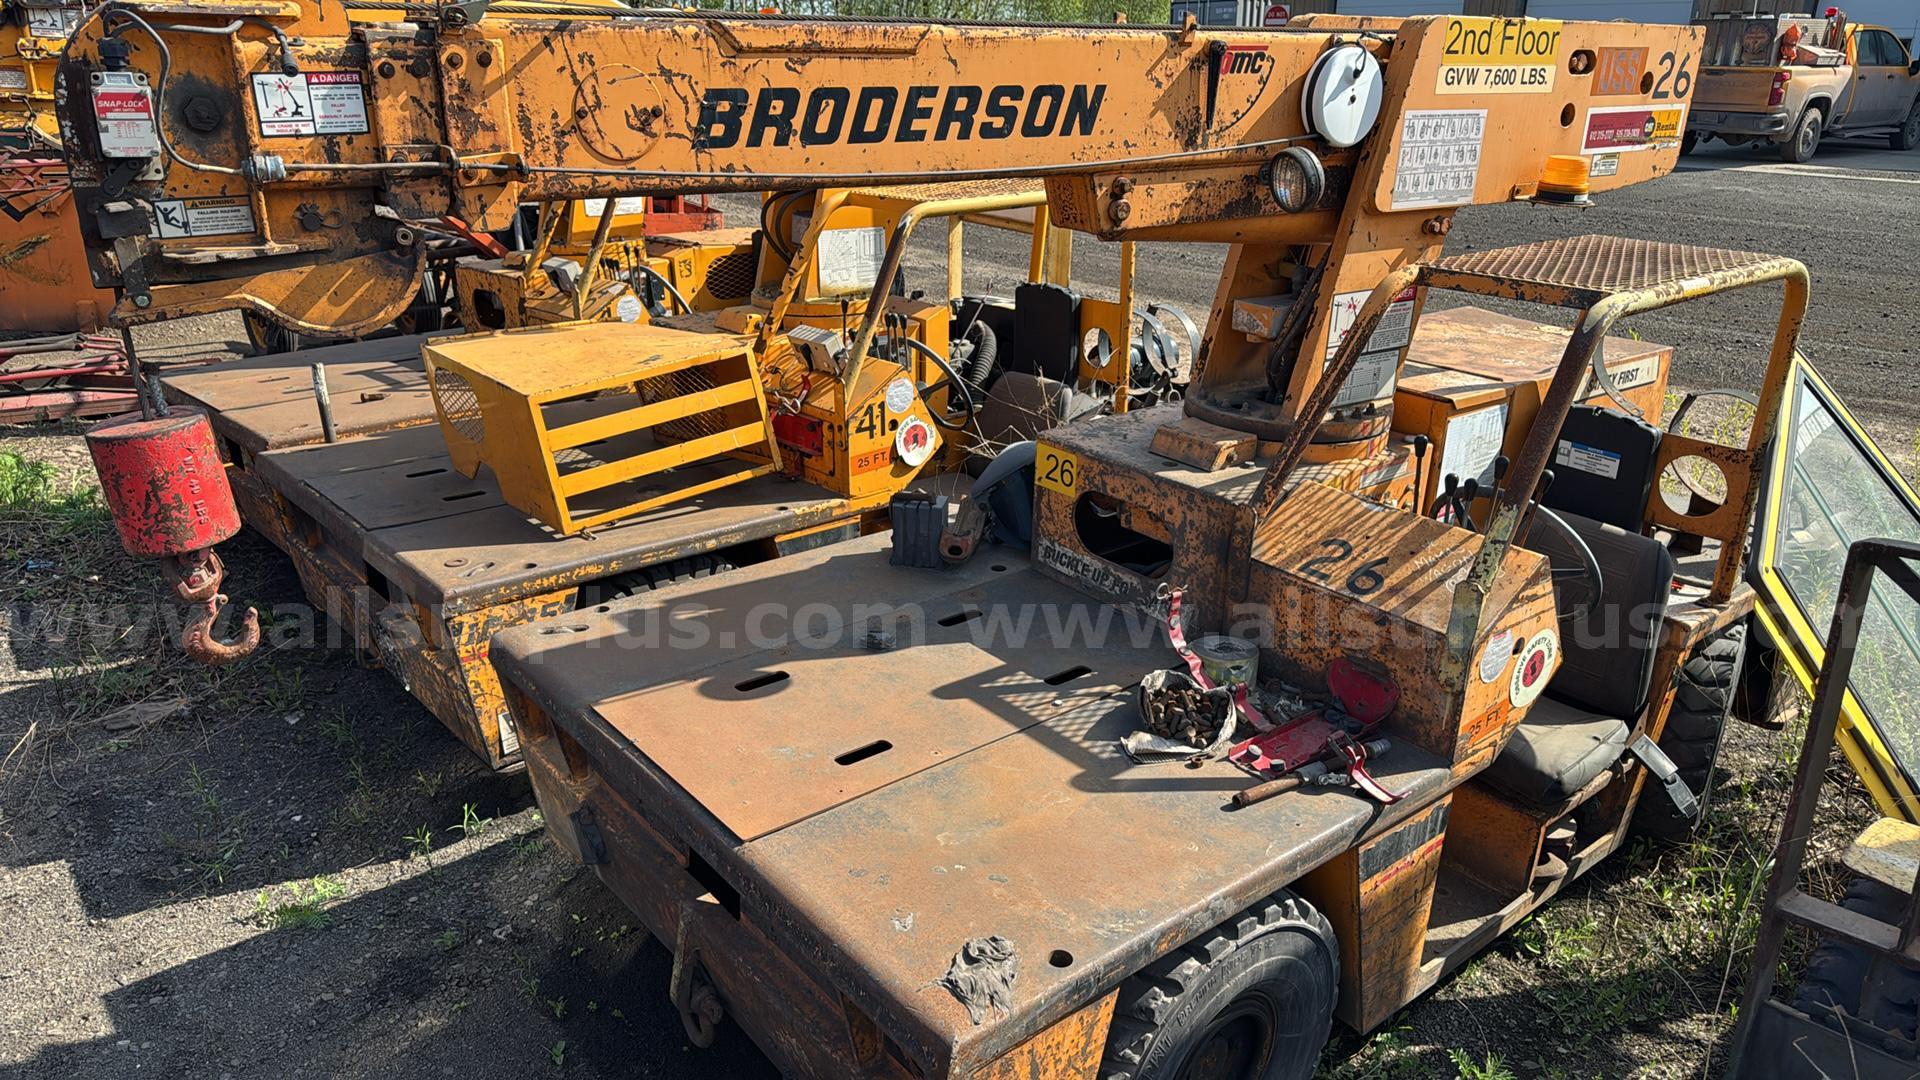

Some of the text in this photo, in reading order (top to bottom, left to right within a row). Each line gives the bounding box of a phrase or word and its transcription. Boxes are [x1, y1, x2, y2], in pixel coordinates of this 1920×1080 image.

[1445, 18, 1561, 56] 2nd Floor
[319, 73, 360, 83] DANGER
[1445, 67, 1548, 89] GVW 7,600 LBS.
[1599, 48, 1641, 92] USS
[1651, 51, 1691, 99] 26
[97, 100, 144, 108] SNAP-LOCK
[692, 83, 1107, 150] BRODERSON
[1617, 367, 1640, 386] FIRST
[855, 401, 886, 440] 41
[857, 451, 888, 469] 25 FT.
[1046, 453, 1074, 488] 26
[1297, 537, 1390, 596] 26
